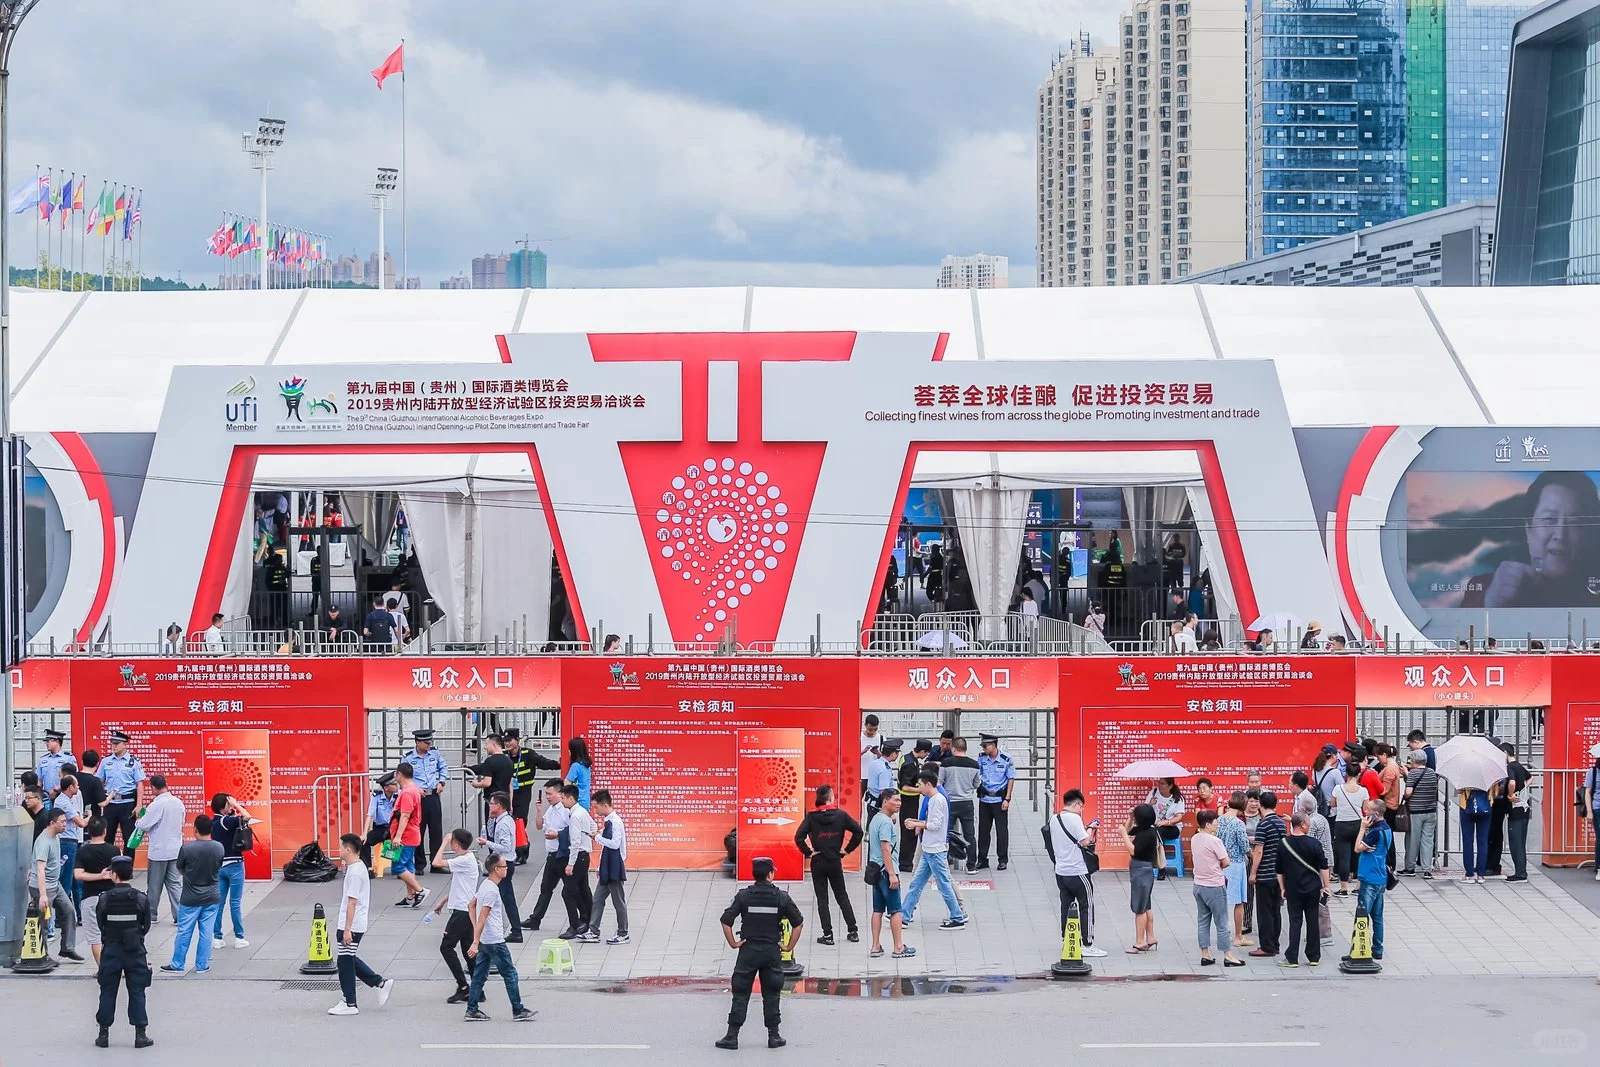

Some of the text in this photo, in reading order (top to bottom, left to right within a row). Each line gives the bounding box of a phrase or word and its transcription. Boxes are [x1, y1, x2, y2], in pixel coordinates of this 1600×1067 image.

[914, 383, 1214, 407] 荟萃全球佳酿 促进投资贸易
[226, 396, 257, 422] ufi
[347, 394, 646, 411] 2019贵州内陆开放型经济试验区投资贸易洽谈会
[460, 413, 488, 421] Alcoholic
[490, 413, 525, 422] Beverages
[526, 413, 544, 421] Expo
[865, 408, 1260, 423] Collecting finest wines from across the globe Promoting investment and trade
[226, 423, 257, 431] Member
[347, 423, 363, 431] 2019
[364, 423, 383, 431] China
[437, 423, 474, 432] Opening-up
[1495, 445, 1511, 458] ufi
[412, 667, 513, 689] 观众入口
[908, 666, 1011, 689] 观众入口
[1404, 665, 1504, 687] 观众入口
[188, 700, 243, 713] 安检须知
[678, 700, 734, 713] 安检须知
[1187, 699, 1243, 712] 安检须知
